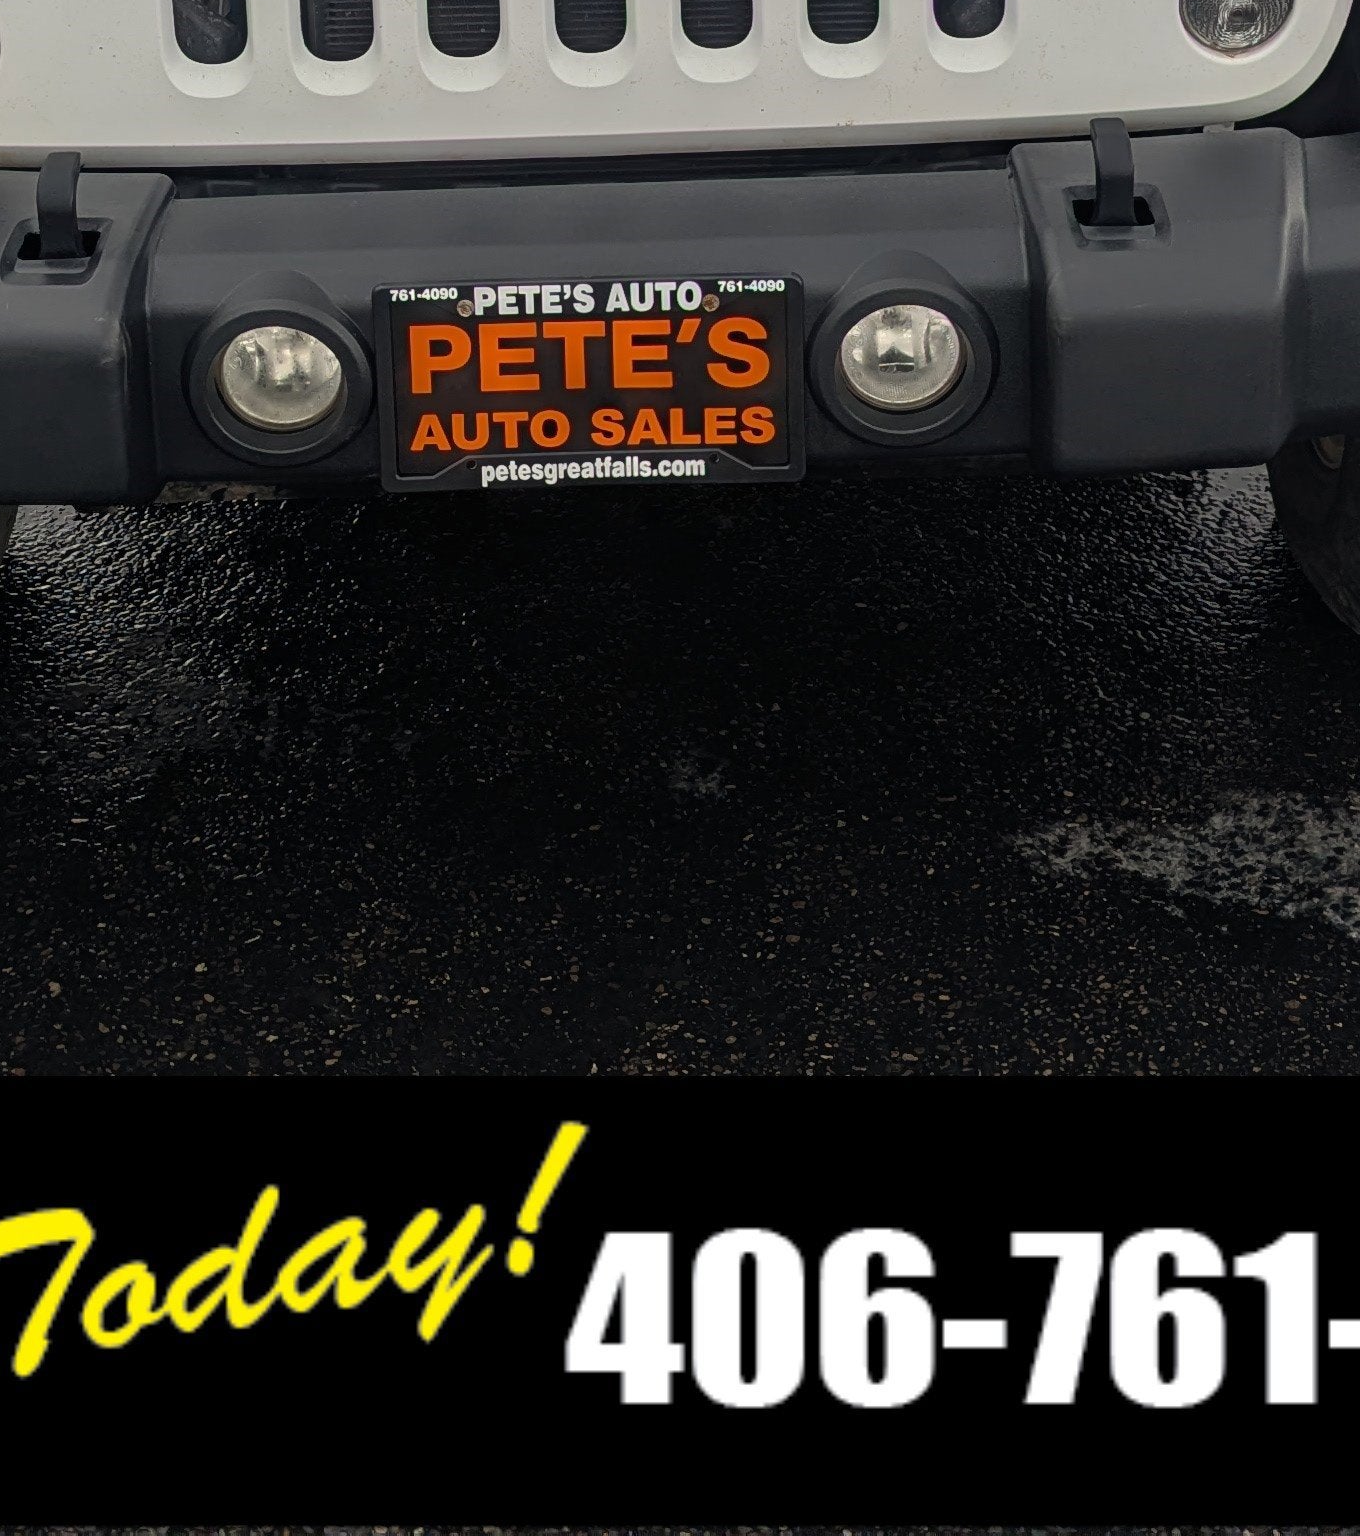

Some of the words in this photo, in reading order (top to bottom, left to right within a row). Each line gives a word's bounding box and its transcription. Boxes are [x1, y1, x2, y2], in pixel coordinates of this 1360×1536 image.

[389, 287, 458, 302] 761-4090
[473, 284, 594, 315] PETE'S
[606, 281, 703, 312] AUTO
[717, 279, 786, 294] 761-4090
[409, 317, 770, 394] PETE'S
[410, 409, 571, 451] AUTO
[590, 406, 776, 446] SALES
[481, 455, 706, 488] petesgreatfalls.com
